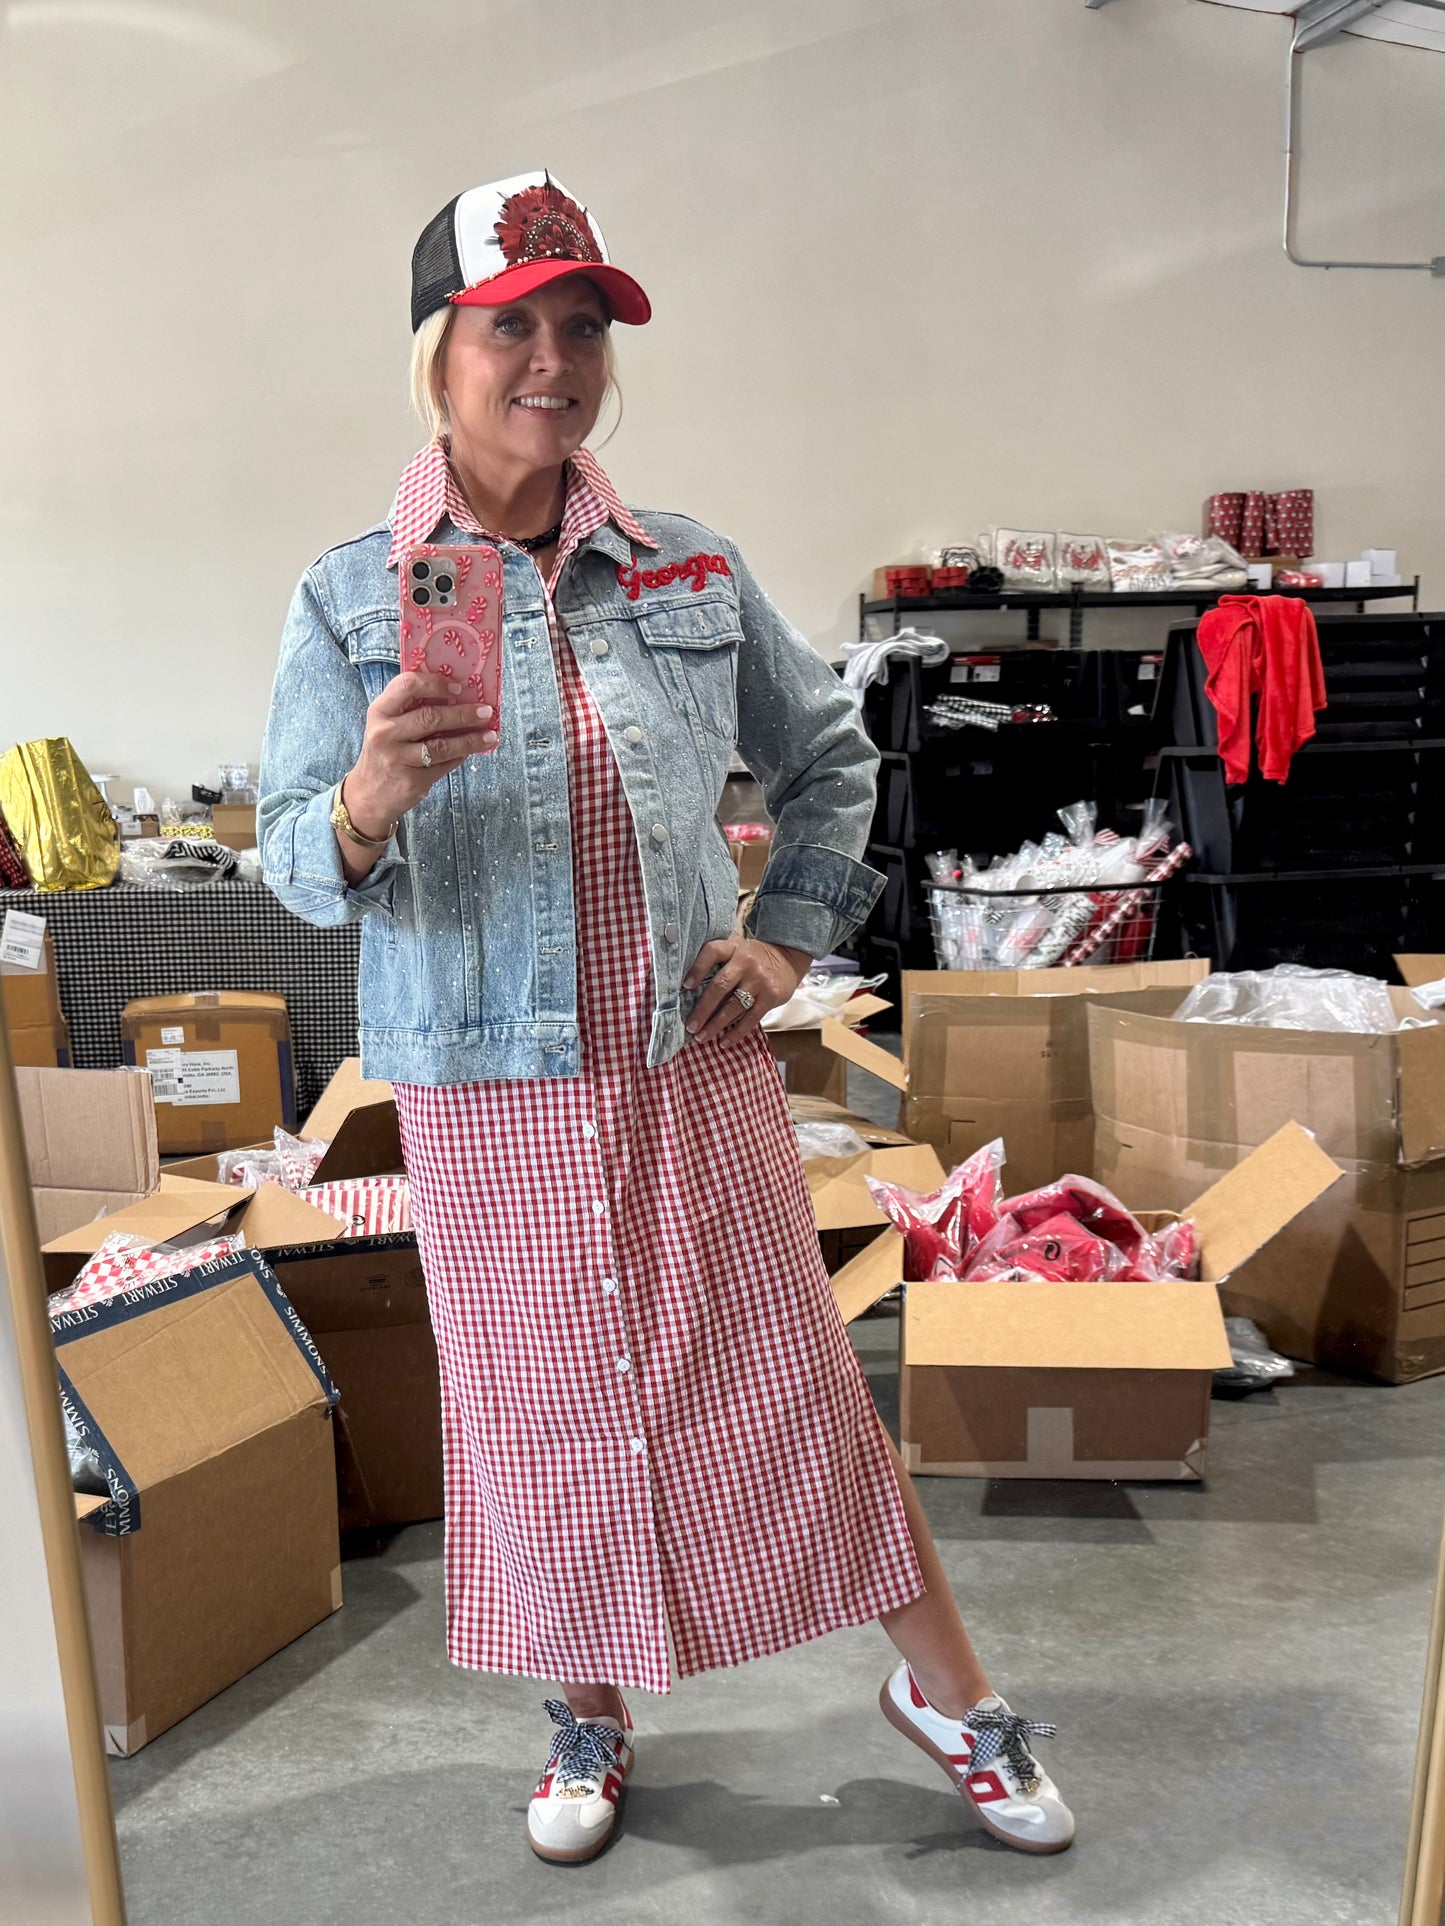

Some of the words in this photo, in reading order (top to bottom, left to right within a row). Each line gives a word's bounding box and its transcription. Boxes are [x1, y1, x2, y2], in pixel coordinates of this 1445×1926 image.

[614, 551, 731, 600] Georgia
[200, 1252, 246, 1277] TEWART
[123, 1277, 178, 1307] STEWART
[51, 1305, 99, 1333] STEWA
[284, 1306, 327, 1375] SIMMONS
[59, 1382, 91, 1437] SIMM
